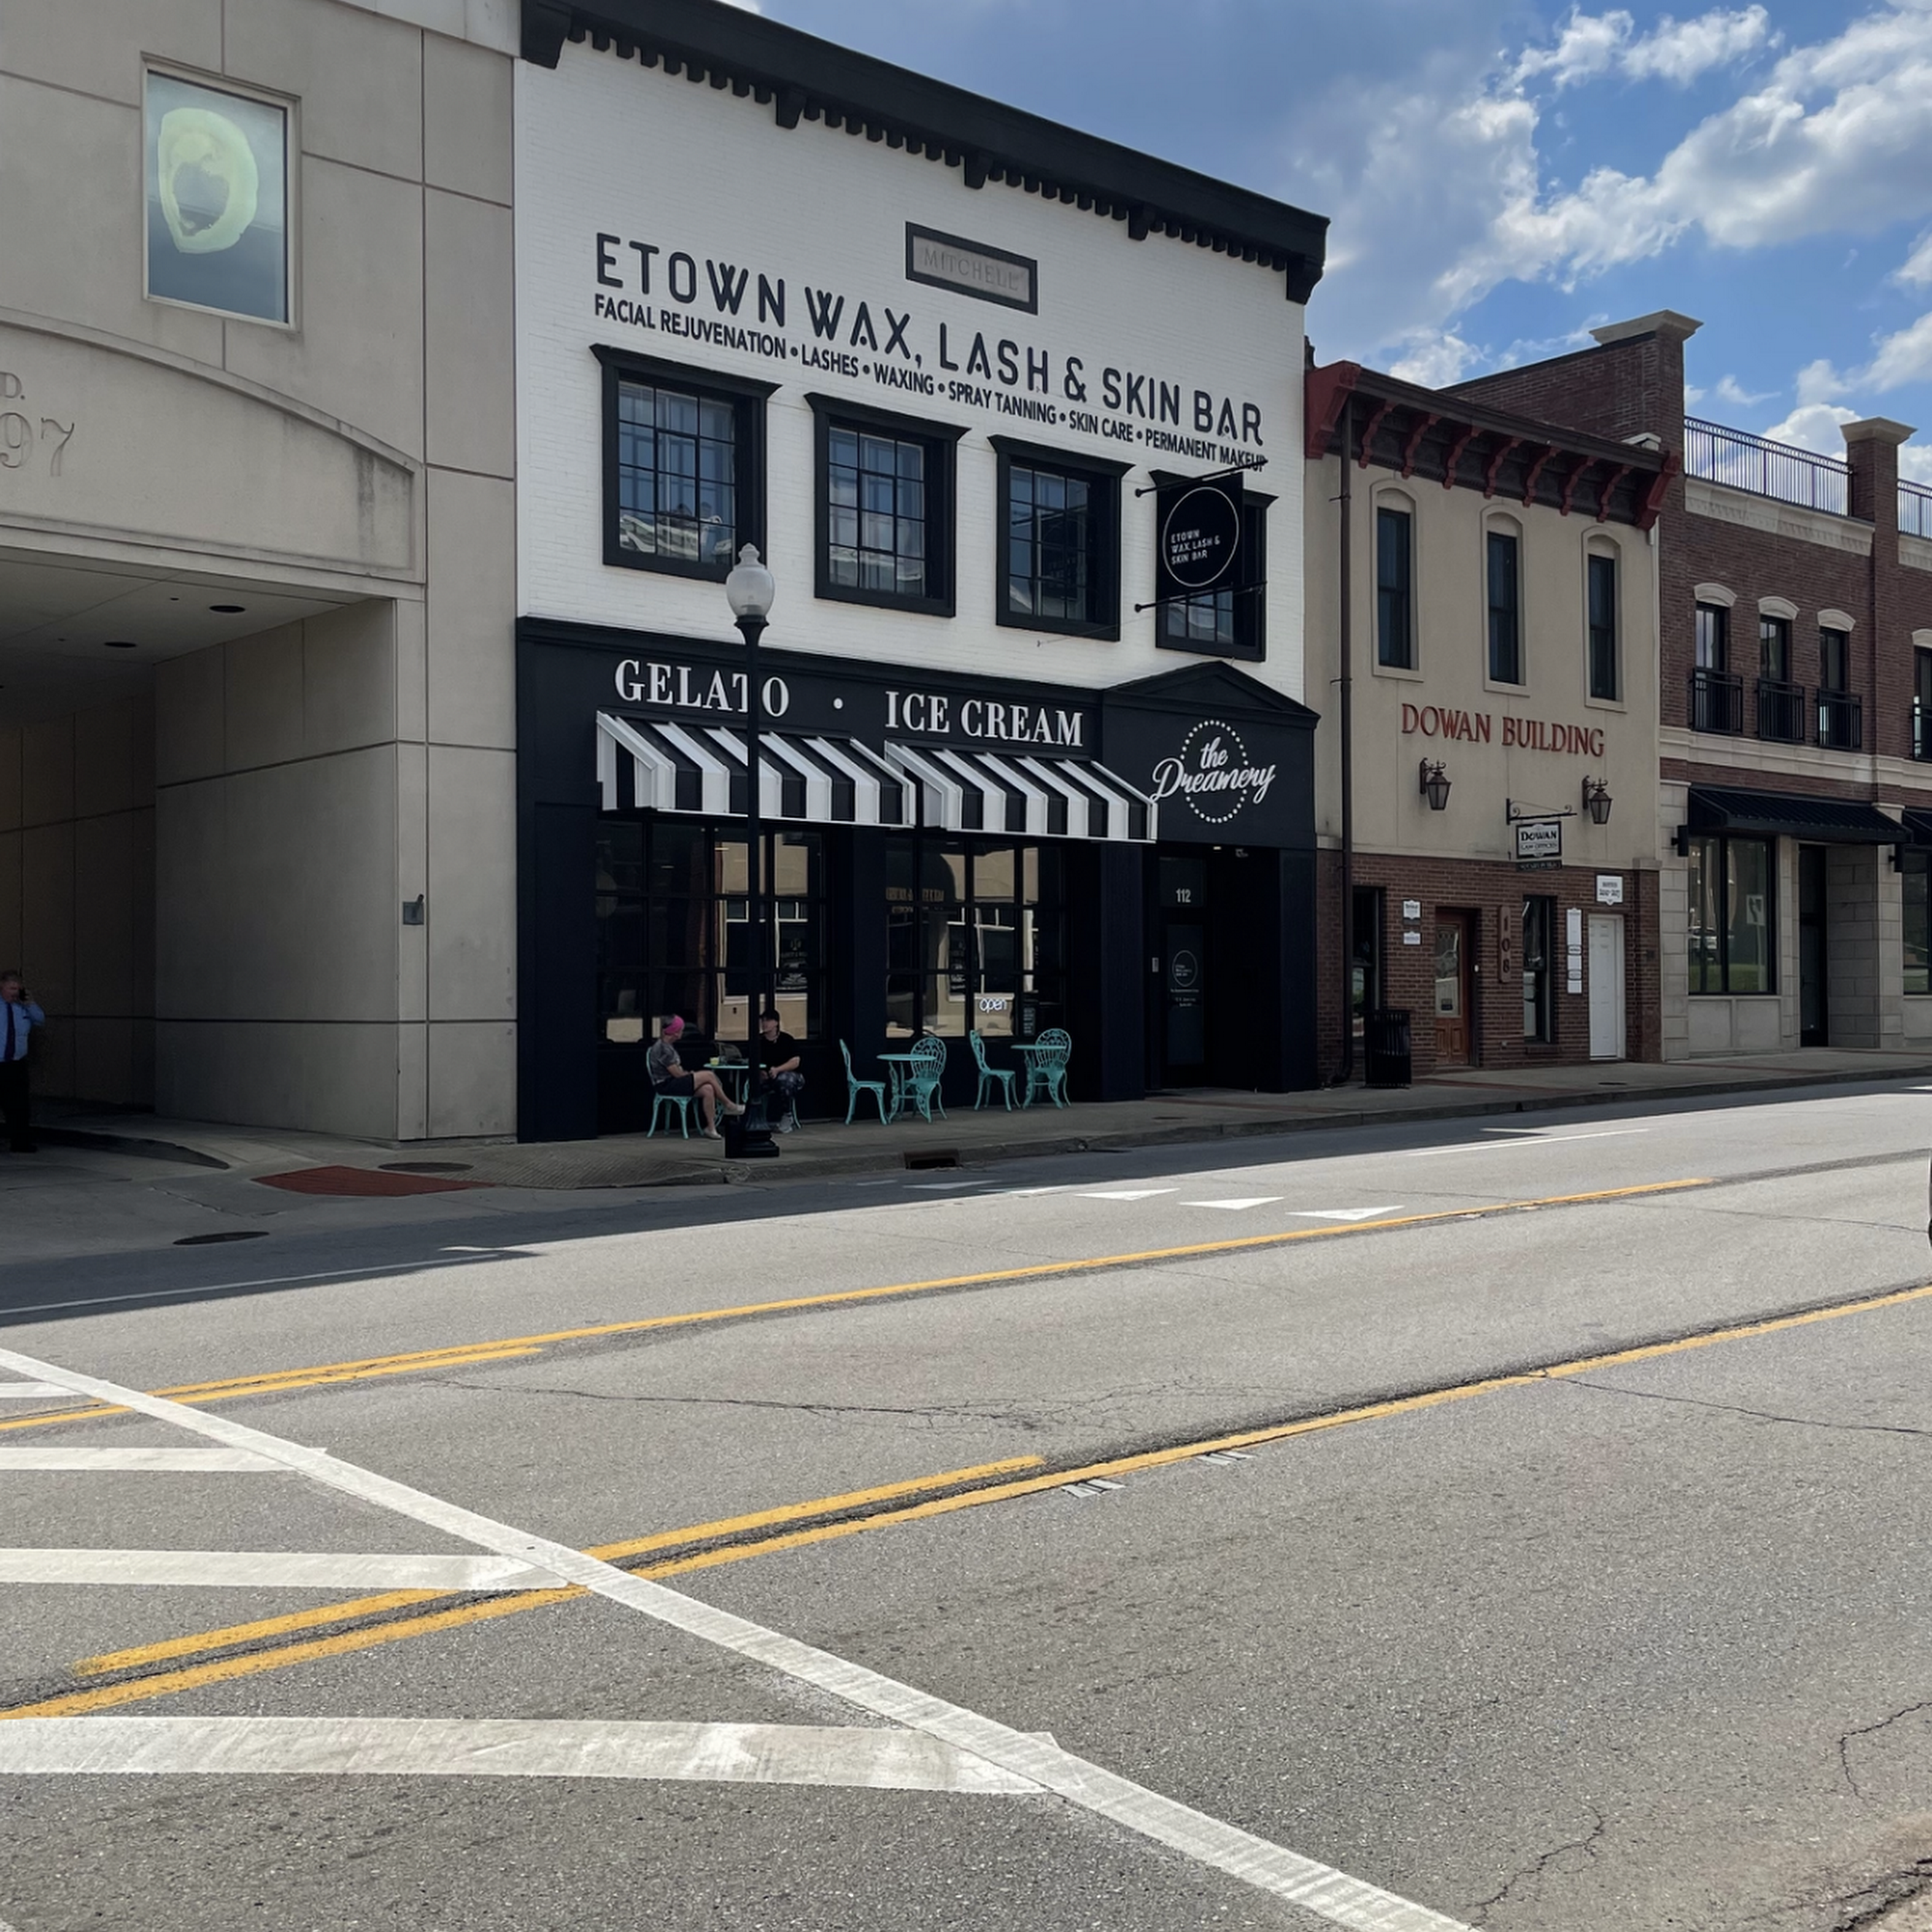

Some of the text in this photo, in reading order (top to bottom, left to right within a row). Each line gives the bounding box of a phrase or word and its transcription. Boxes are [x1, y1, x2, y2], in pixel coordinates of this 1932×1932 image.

[924, 247, 1019, 292] MITCHELL
[596, 232, 1264, 446] ETOWN WAX, LASH & SKIN BAR
[594, 293, 656, 330] FACIAL
[660, 309, 786, 359] REJUVENATION
[801, 343, 859, 378] LASHES
[873, 361, 934, 395] WAXING
[948, 381, 992, 410] SPRAY
[995, 391, 1056, 425] TANNING
[1068, 414, 1098, 435] SKIN
[1101, 418, 1133, 442] CARE
[1145, 428, 1217, 462] PERMANENT
[1171, 529, 1200, 544] ETOWN
[1171, 550, 1208, 565] SKIN BAR
[1192, 538, 1213, 550] LASH
[614, 659, 1083, 748] GELATO ICE CREAM
[1200, 736, 1228, 769] the
[1402, 703, 1605, 757] DOWAN BUILDING
[1150, 757, 1276, 804] Dreamery
[1176, 888, 1191, 903] 112
[1501, 915, 1511, 974] 108
[980, 998, 1007, 1013] open
